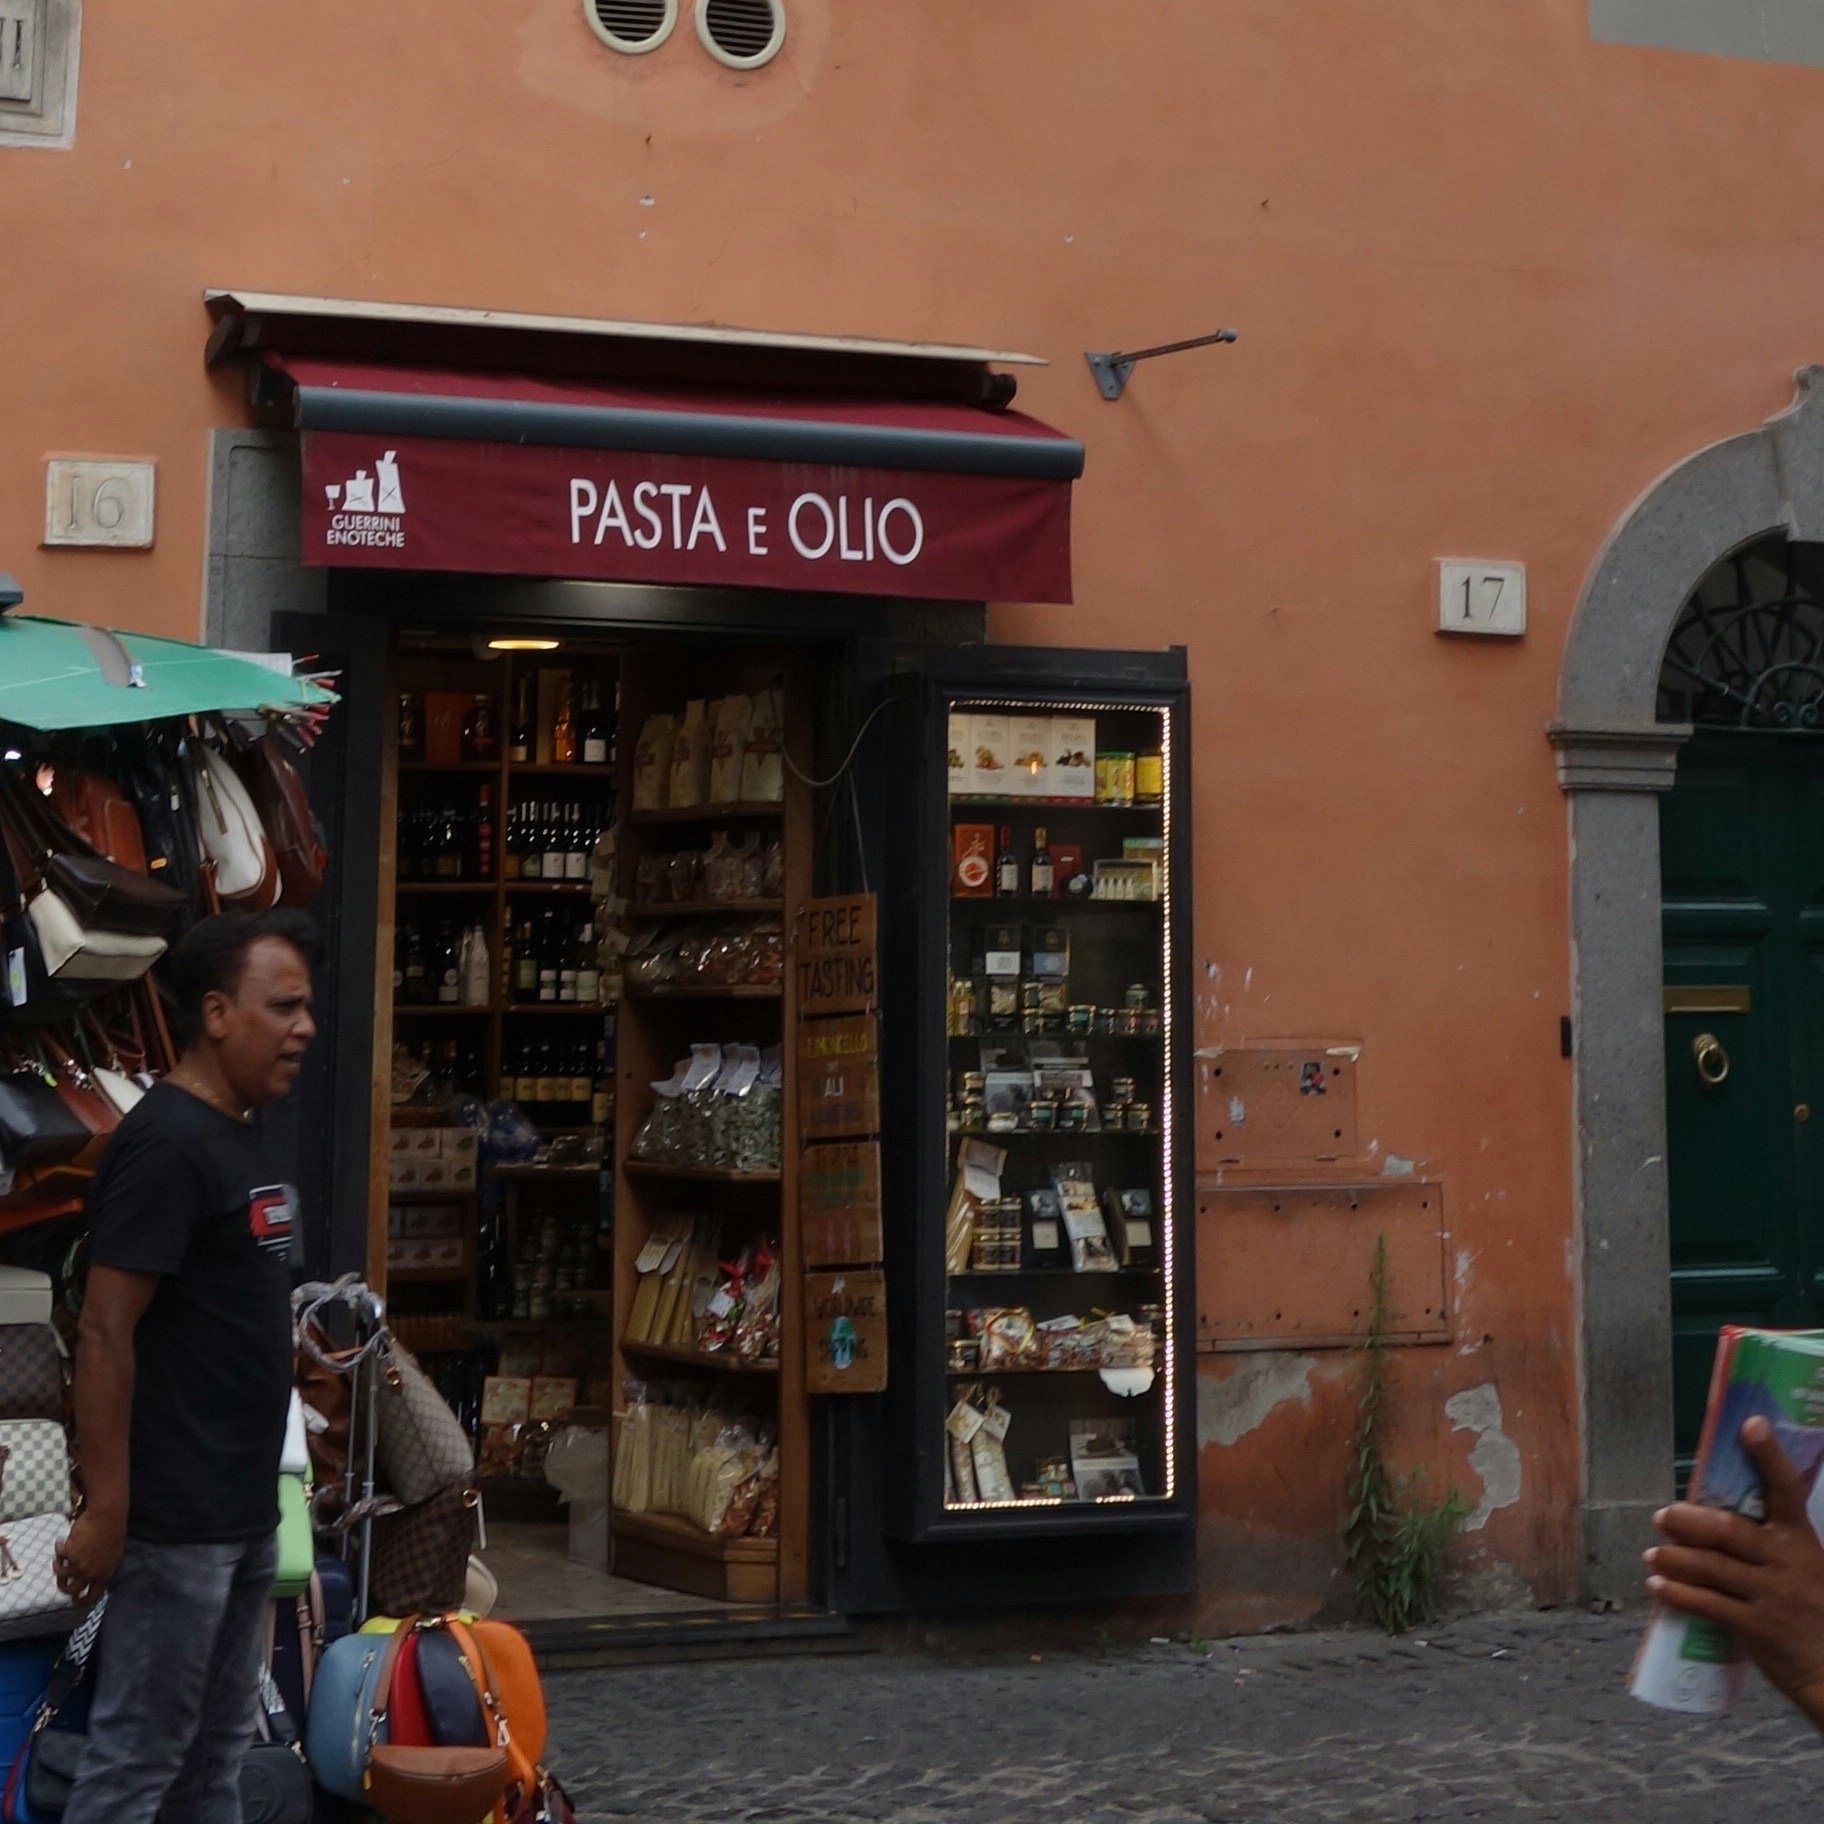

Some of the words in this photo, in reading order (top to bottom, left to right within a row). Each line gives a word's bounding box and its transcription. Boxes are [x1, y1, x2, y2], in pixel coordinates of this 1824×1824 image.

[69, 475, 133, 530] 16
[331, 514, 402, 535] GUERRINI
[569, 478, 727, 552] PASTA
[746, 506, 769, 557] E
[787, 491, 924, 566] OLIO
[326, 528, 406, 549] ENOTECHE
[1461, 575, 1506, 621] 17
[808, 904, 863, 949] FREE
[798, 954, 874, 999] TASTING
